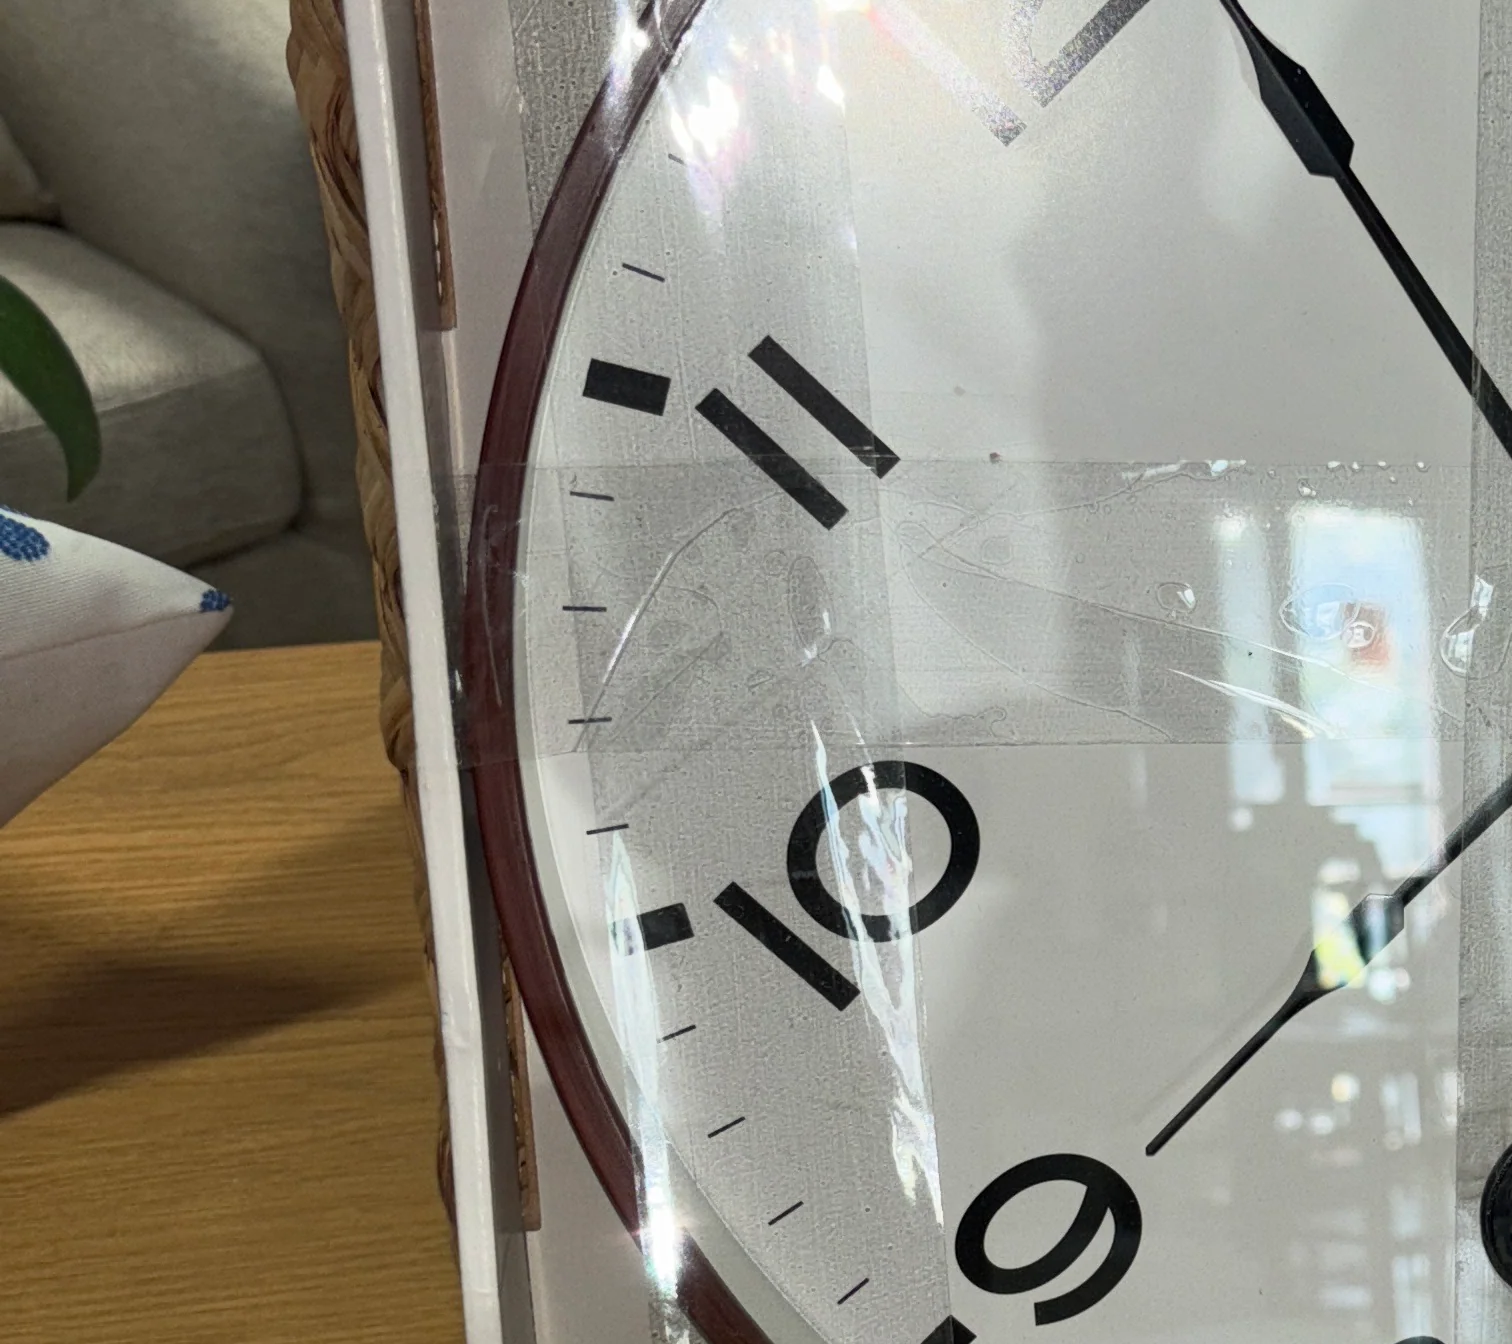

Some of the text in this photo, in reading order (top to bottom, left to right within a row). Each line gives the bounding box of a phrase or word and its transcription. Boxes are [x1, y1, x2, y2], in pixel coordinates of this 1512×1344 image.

[695, 336, 901, 531] 11
[713, 760, 981, 1012] 10
[954, 1153, 1143, 1326] 9
